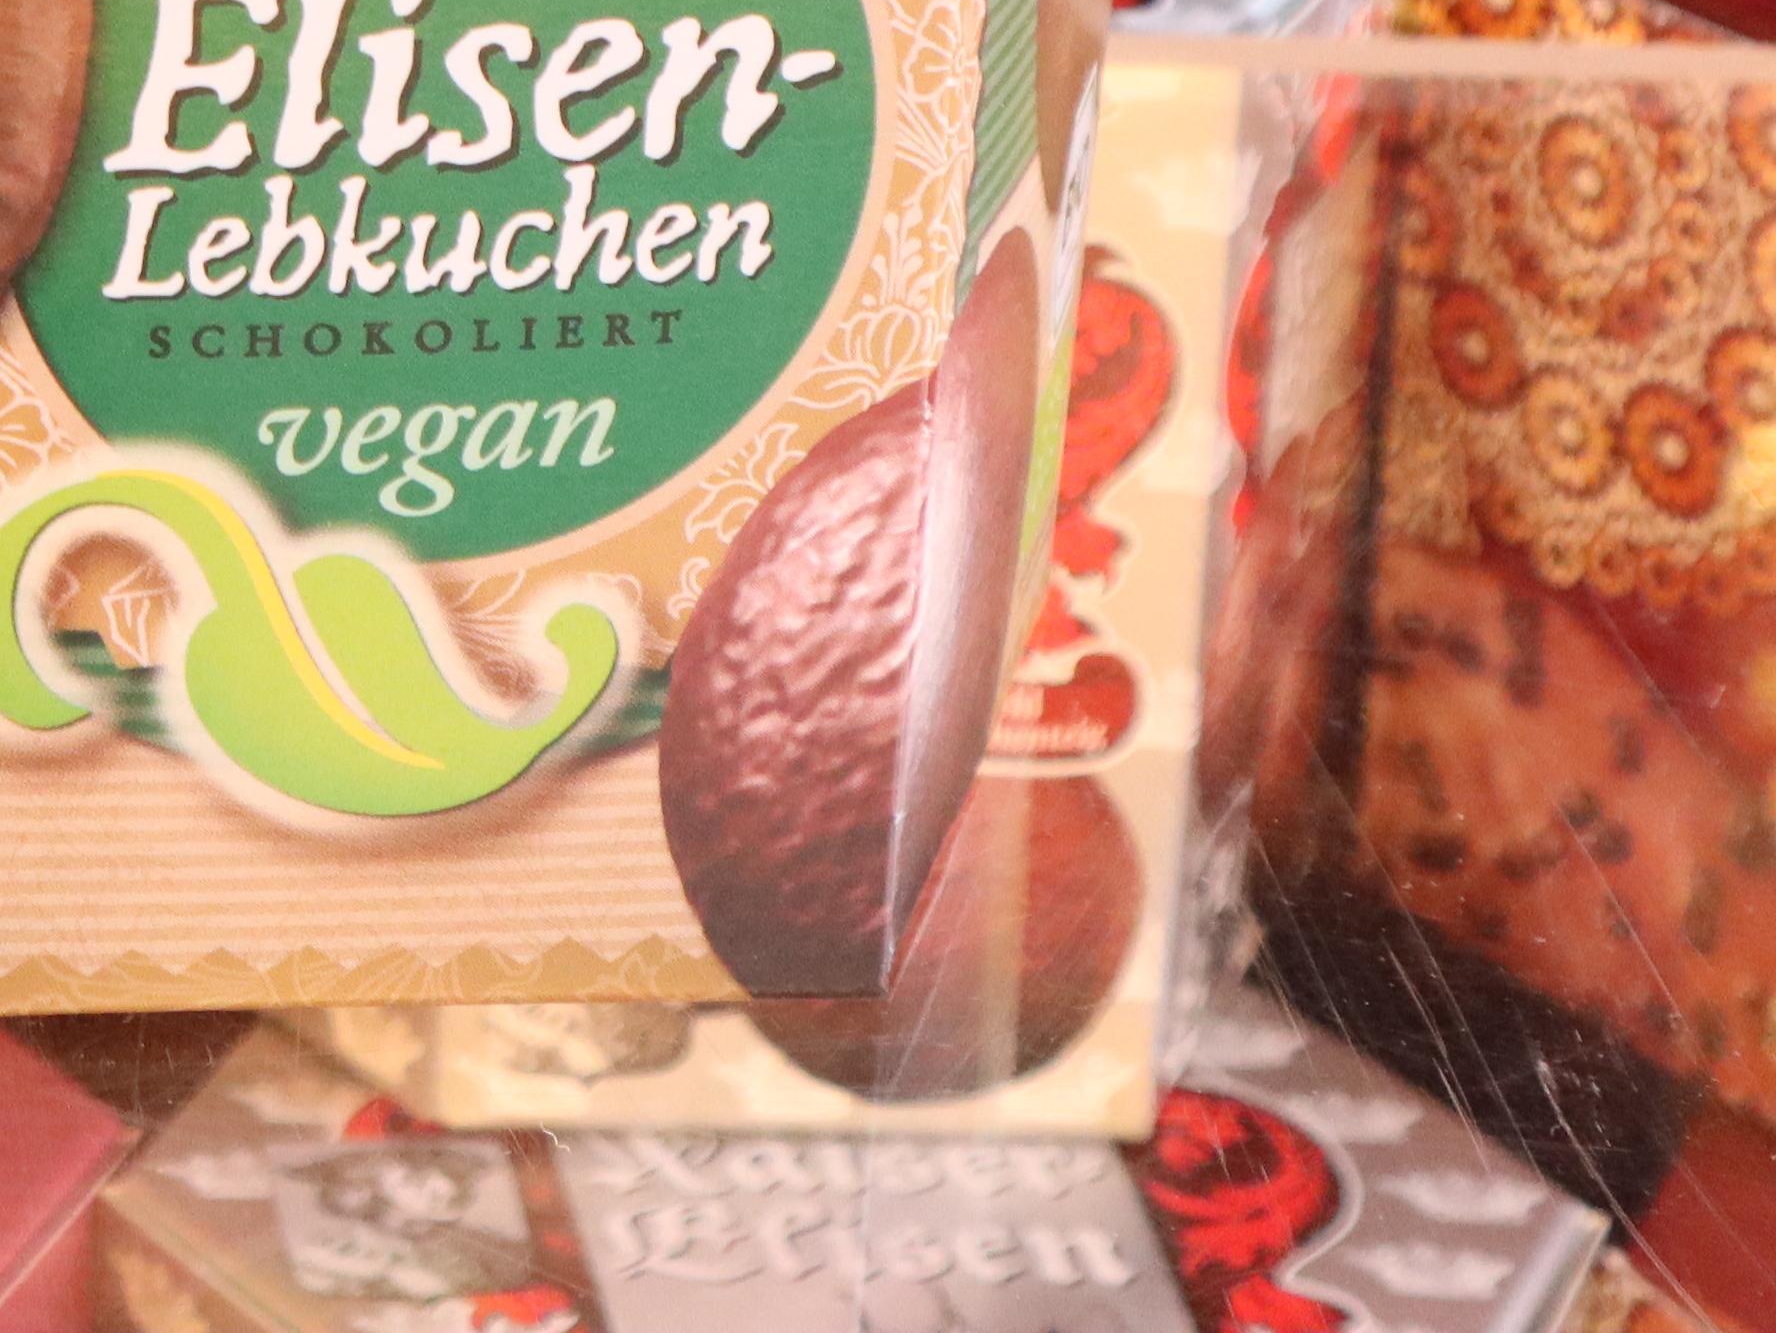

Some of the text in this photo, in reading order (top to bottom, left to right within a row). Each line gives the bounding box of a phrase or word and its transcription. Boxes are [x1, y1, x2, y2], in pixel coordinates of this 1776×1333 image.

[100, 161, 774, 301] Lebkuchen
[147, 309, 686, 360] SCHOKOLIERT
[256, 393, 619, 520] vegan
